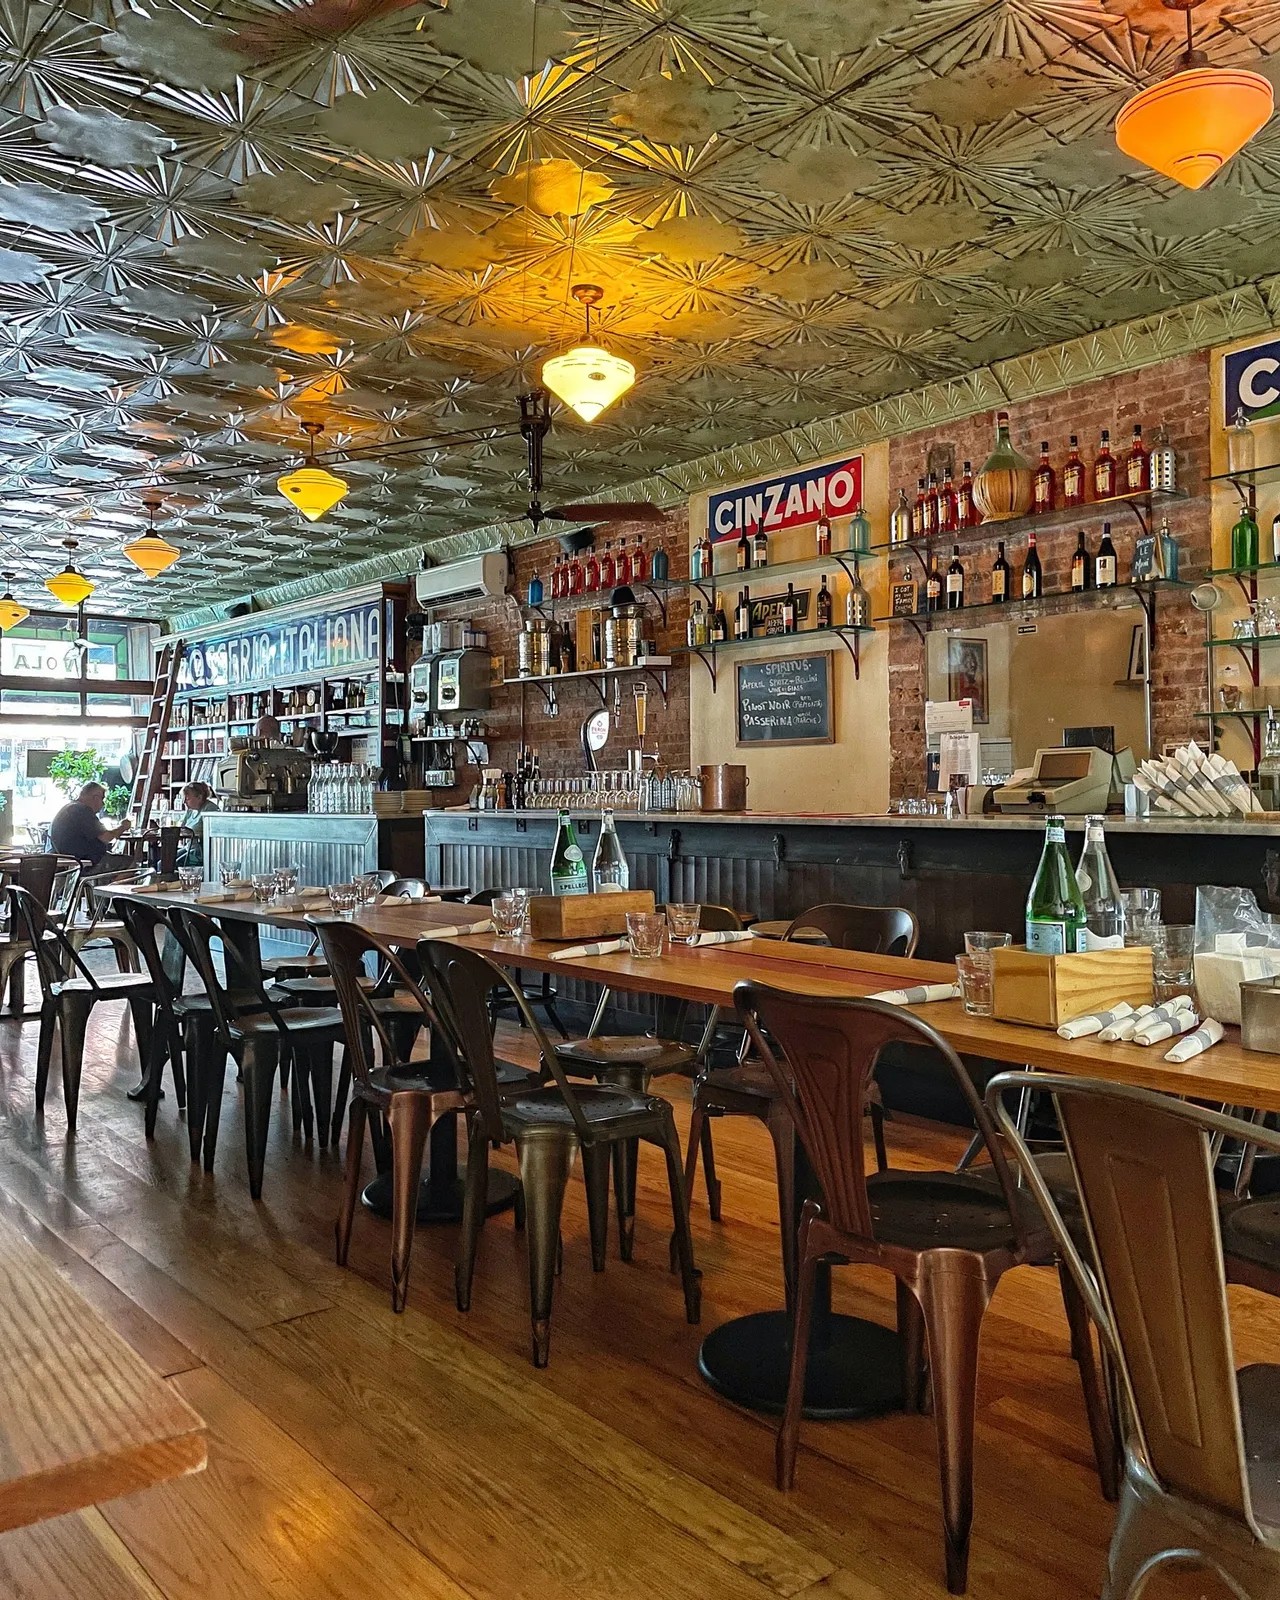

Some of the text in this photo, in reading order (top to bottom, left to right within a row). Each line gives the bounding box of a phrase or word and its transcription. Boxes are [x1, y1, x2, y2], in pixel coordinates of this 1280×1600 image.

[715, 470, 854, 535] CINZANO
[1140, 546, 1149, 556] LE
[280, 608, 380, 675] ITALIANA
[742, 698, 767, 712] PINOT
[768, 699, 790, 710] NOIR
